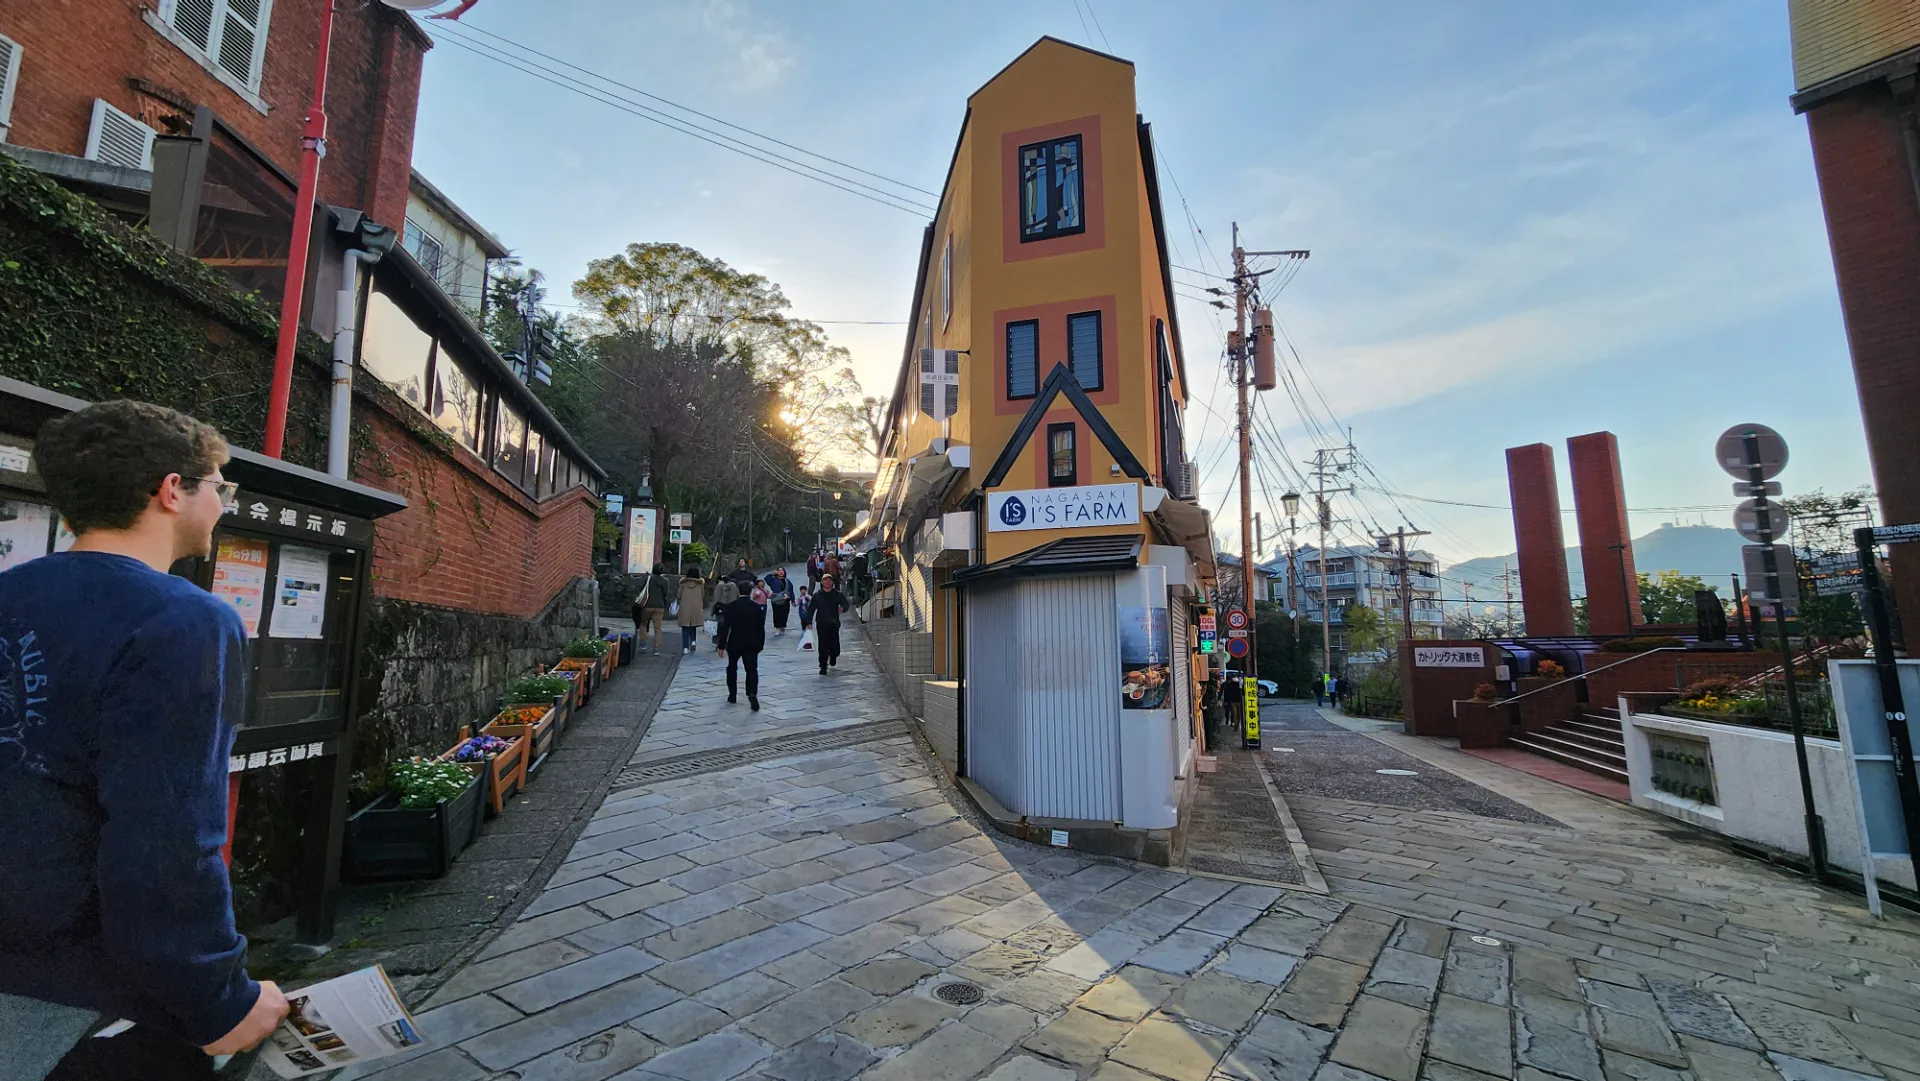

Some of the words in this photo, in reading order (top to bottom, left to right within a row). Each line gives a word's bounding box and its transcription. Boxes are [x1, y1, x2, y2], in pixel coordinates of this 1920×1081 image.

[1031, 489, 1126, 505] NAGASAKI
[1005, 502, 1021, 518] I'S
[1031, 505, 1056, 523] I'S
[1065, 501, 1126, 521] FARM
[1231, 615, 1243, 625] 30
[1205, 631, 1214, 640] P
[1418, 651, 1480, 663] カトリック大浦教会
